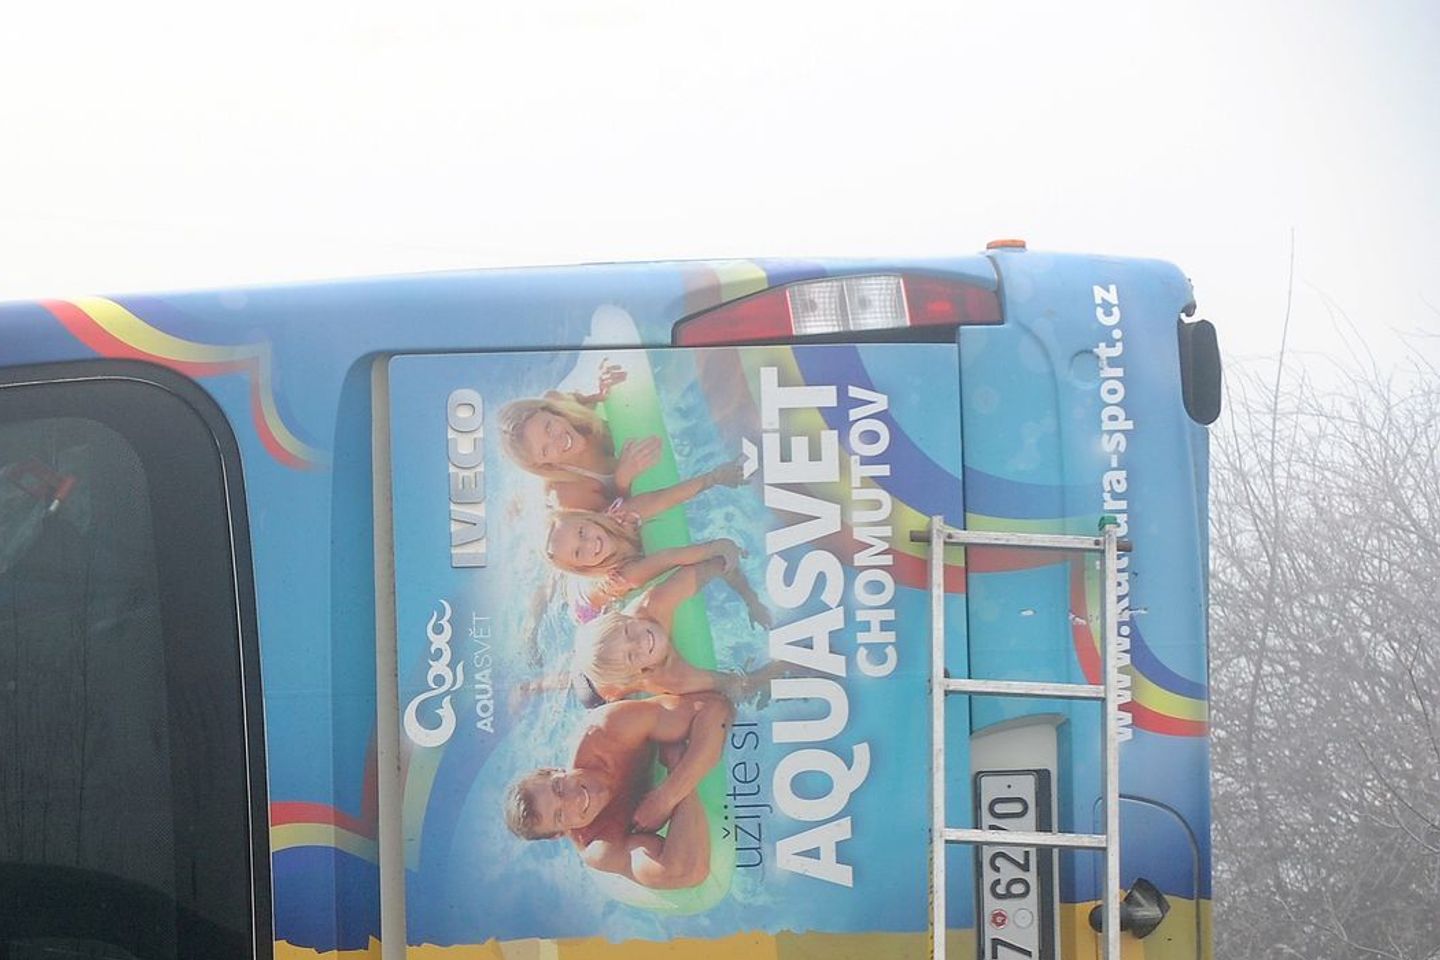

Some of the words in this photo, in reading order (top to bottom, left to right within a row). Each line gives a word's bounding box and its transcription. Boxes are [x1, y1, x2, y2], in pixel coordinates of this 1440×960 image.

[446, 387, 487, 568] IVECO
[848, 385, 898, 678] CHOMUTOV
[469, 611, 494, 734] AQUASVĚT
[743, 366, 871, 888] AQUASVĚT
[721, 722, 760, 751] si
[721, 759, 773, 869] užijte
